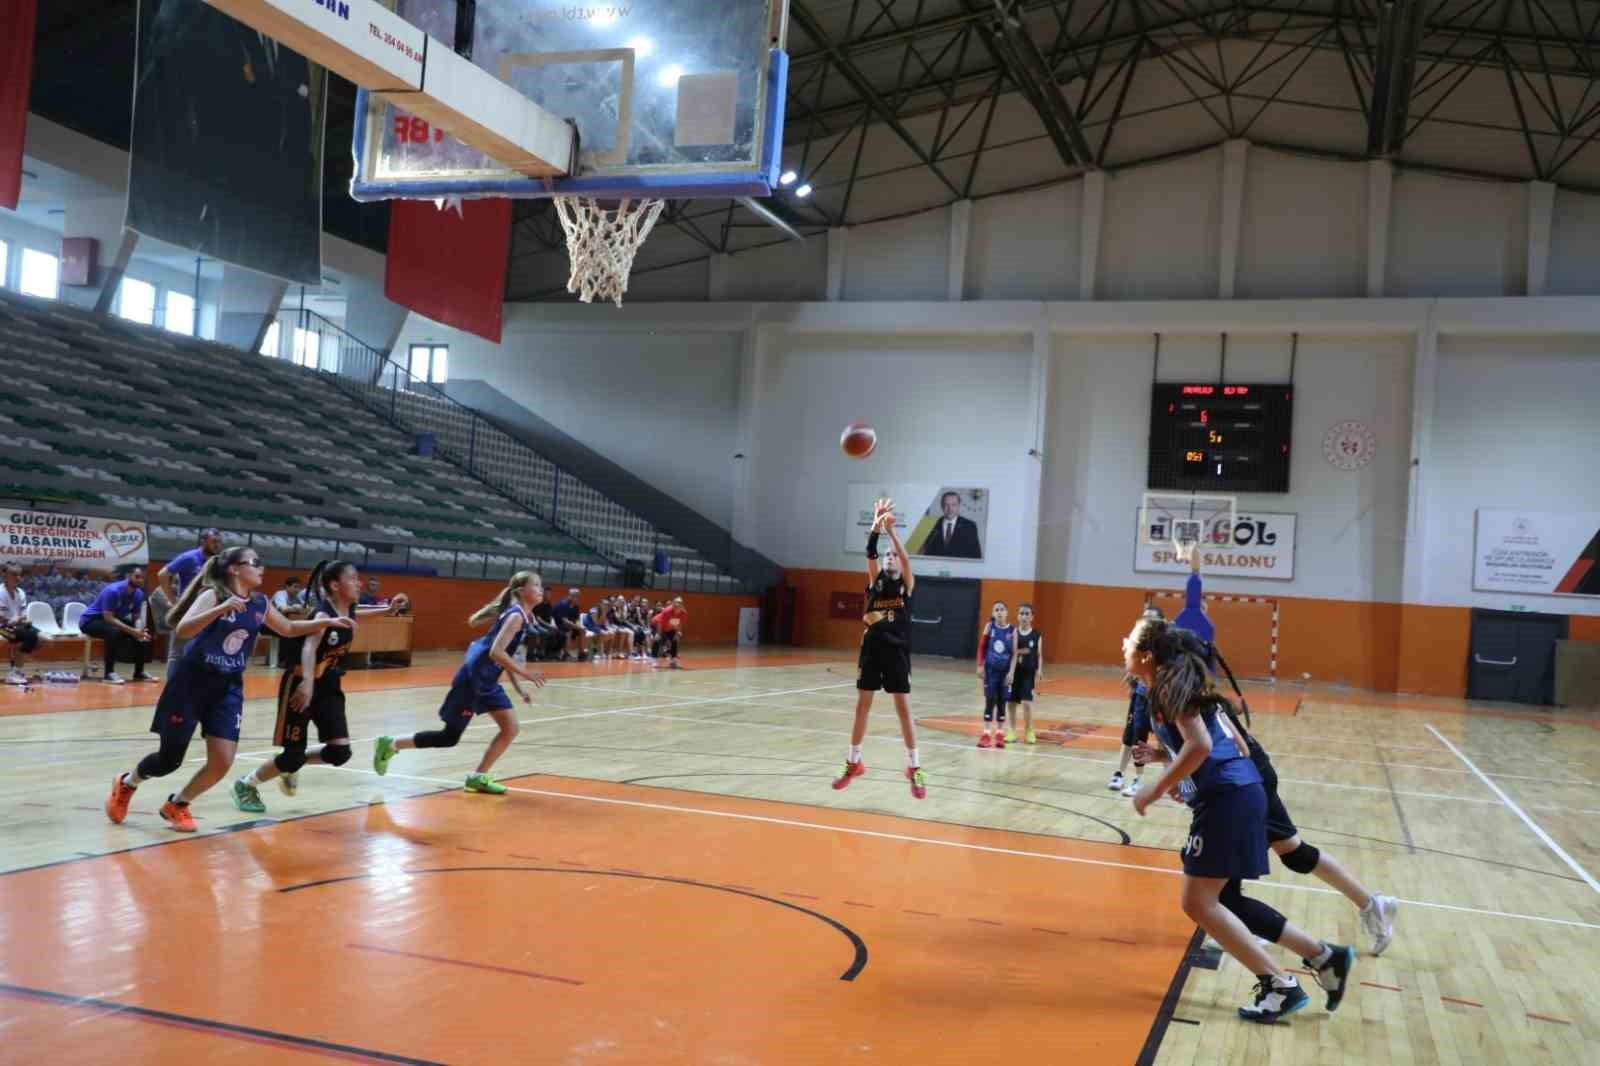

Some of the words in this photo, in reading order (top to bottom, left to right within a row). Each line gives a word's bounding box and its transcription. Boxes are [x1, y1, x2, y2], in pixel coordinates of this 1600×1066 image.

[10, 512, 89, 530] GÜCÜNÜZ
[9, 534, 92, 549] BAŞARINIZ
[1204, 552, 1277, 569] SALONU
[286, 723, 302, 742] 12
